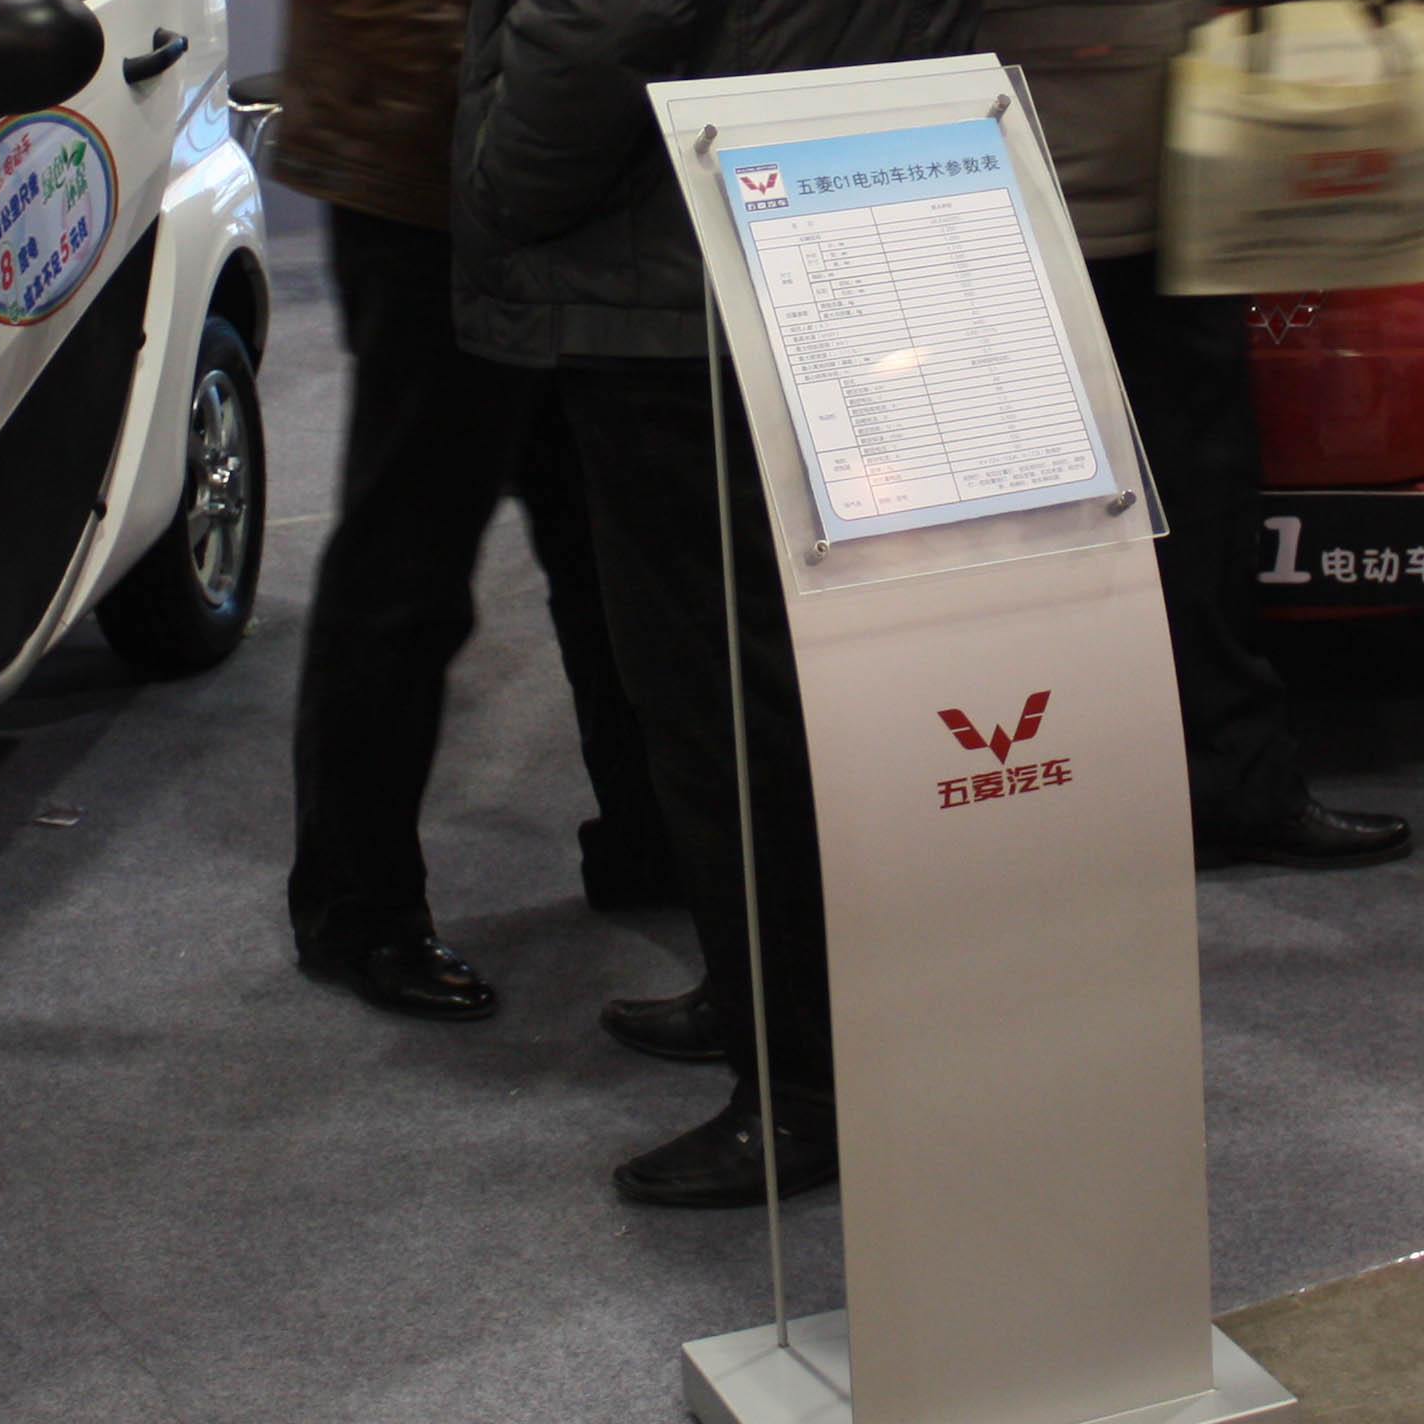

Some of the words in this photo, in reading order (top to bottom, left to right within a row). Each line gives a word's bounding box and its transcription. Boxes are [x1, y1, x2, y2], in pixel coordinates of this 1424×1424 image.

[796, 153, 1002, 197] 五菱C1电动车技术参数表
[936, 757, 1073, 810] 五菱汽车
